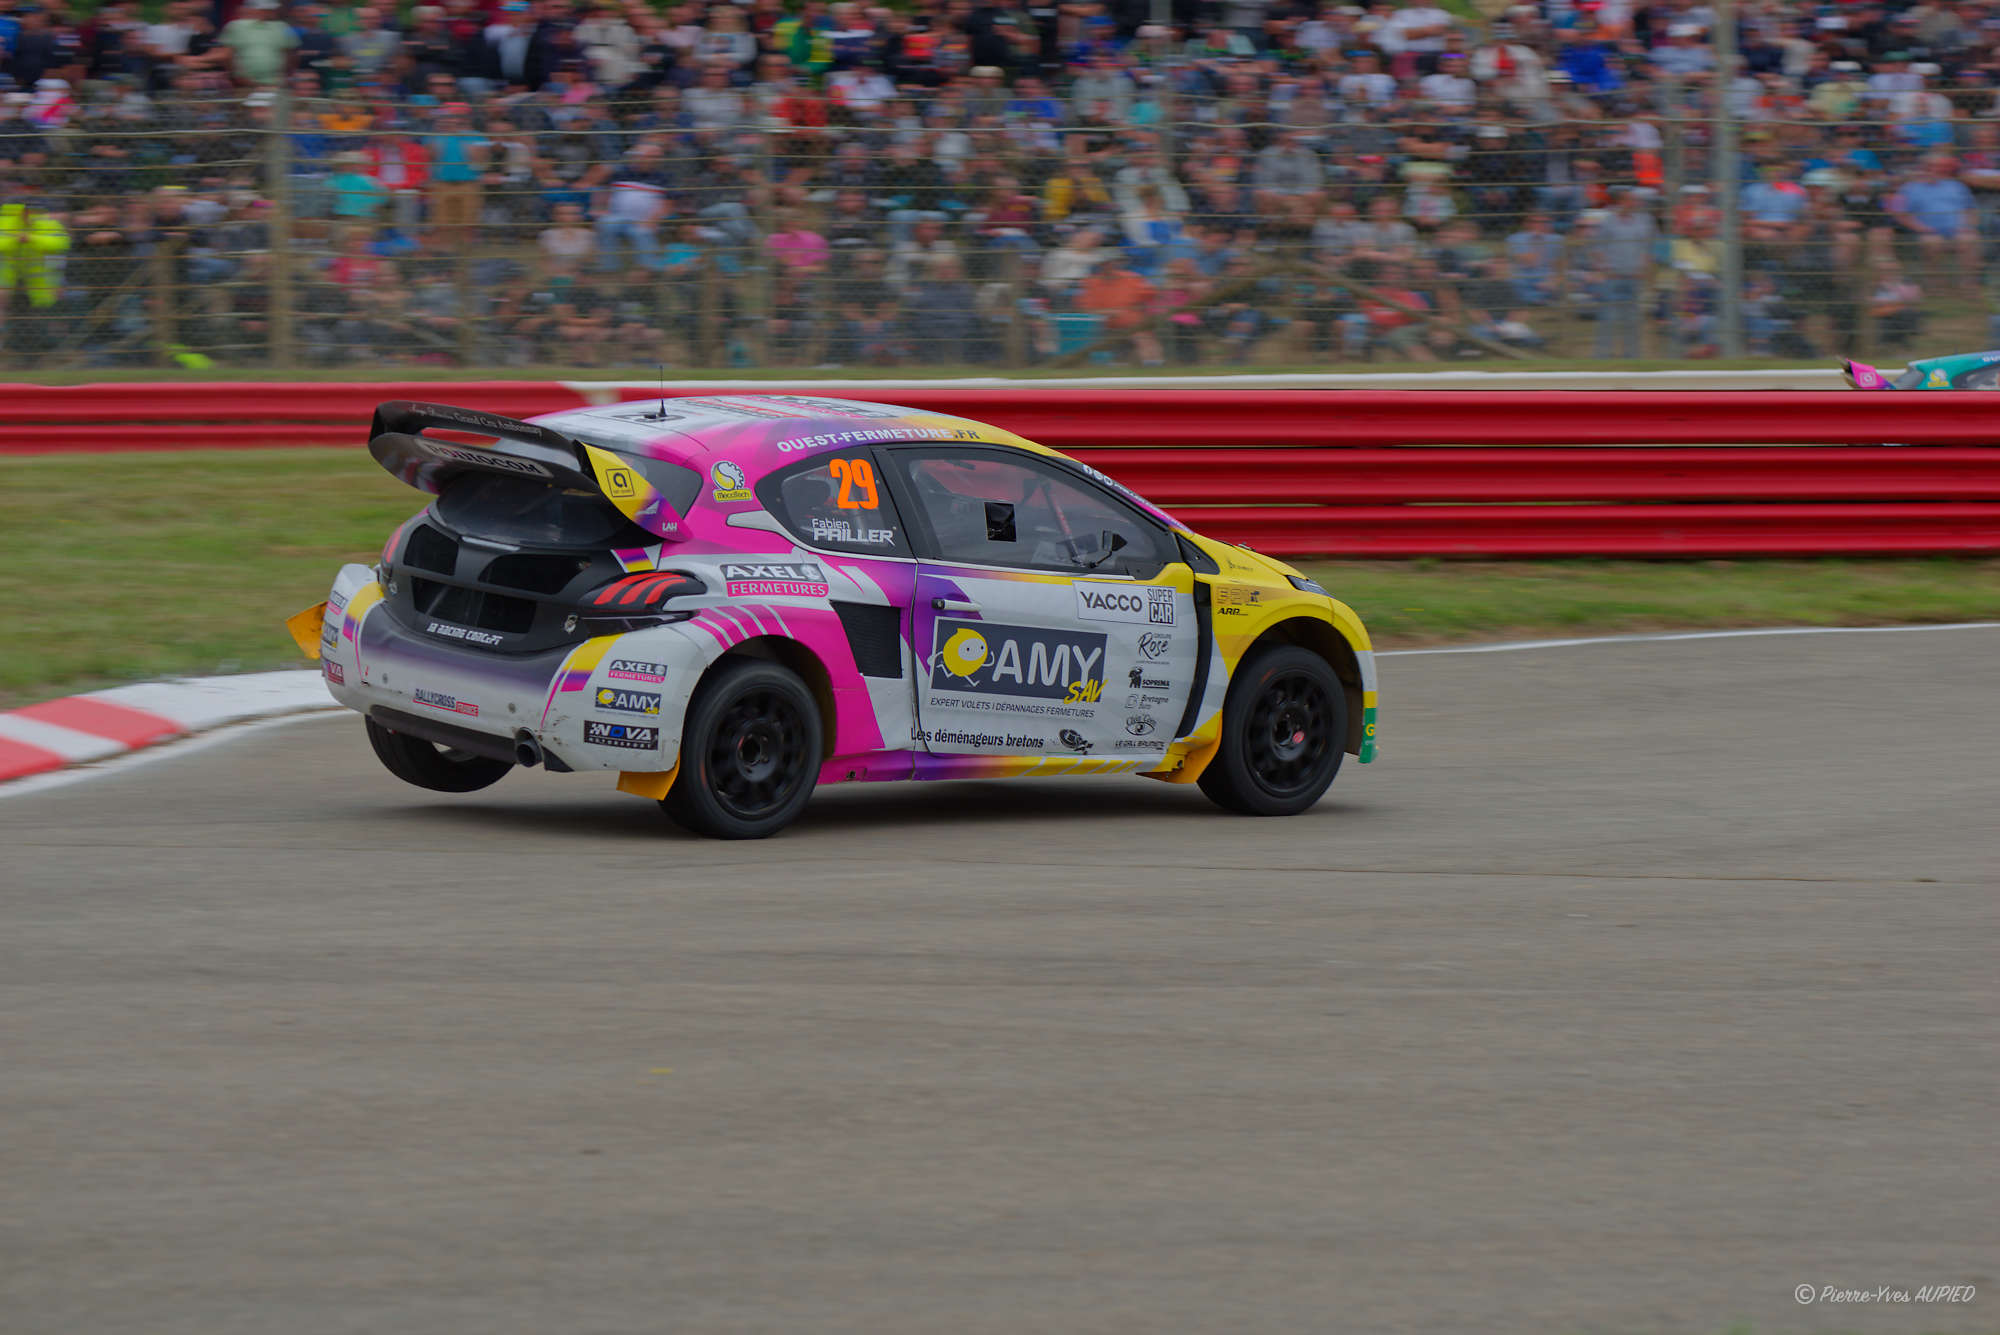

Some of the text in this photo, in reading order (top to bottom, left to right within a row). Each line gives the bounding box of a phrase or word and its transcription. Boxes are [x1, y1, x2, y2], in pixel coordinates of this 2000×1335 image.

[776, 428, 980, 452] OUEST-FERMETURE.FR
[829, 458, 879, 510] 29
[662, 522, 678, 531] LAH
[811, 518, 850, 529] Fabien
[731, 583, 826, 595] FERMETURES
[1147, 588, 1172, 602] SUPER
[1080, 591, 1143, 612] YACCO
[1150, 602, 1173, 624] CAR
[1138, 632, 1168, 660] Rose
[610, 660, 656, 674] AXEL
[992, 639, 1102, 688] AMY
[615, 693, 660, 710] AMY
[1063, 679, 1108, 704] SAV
[931, 697, 960, 708] EXPERT
[961, 699, 990, 710] VOLETS
[1045, 706, 1095, 718] FERMETURES
[934, 728, 1004, 748] déménageurs
[1006, 733, 1044, 748] bretons
